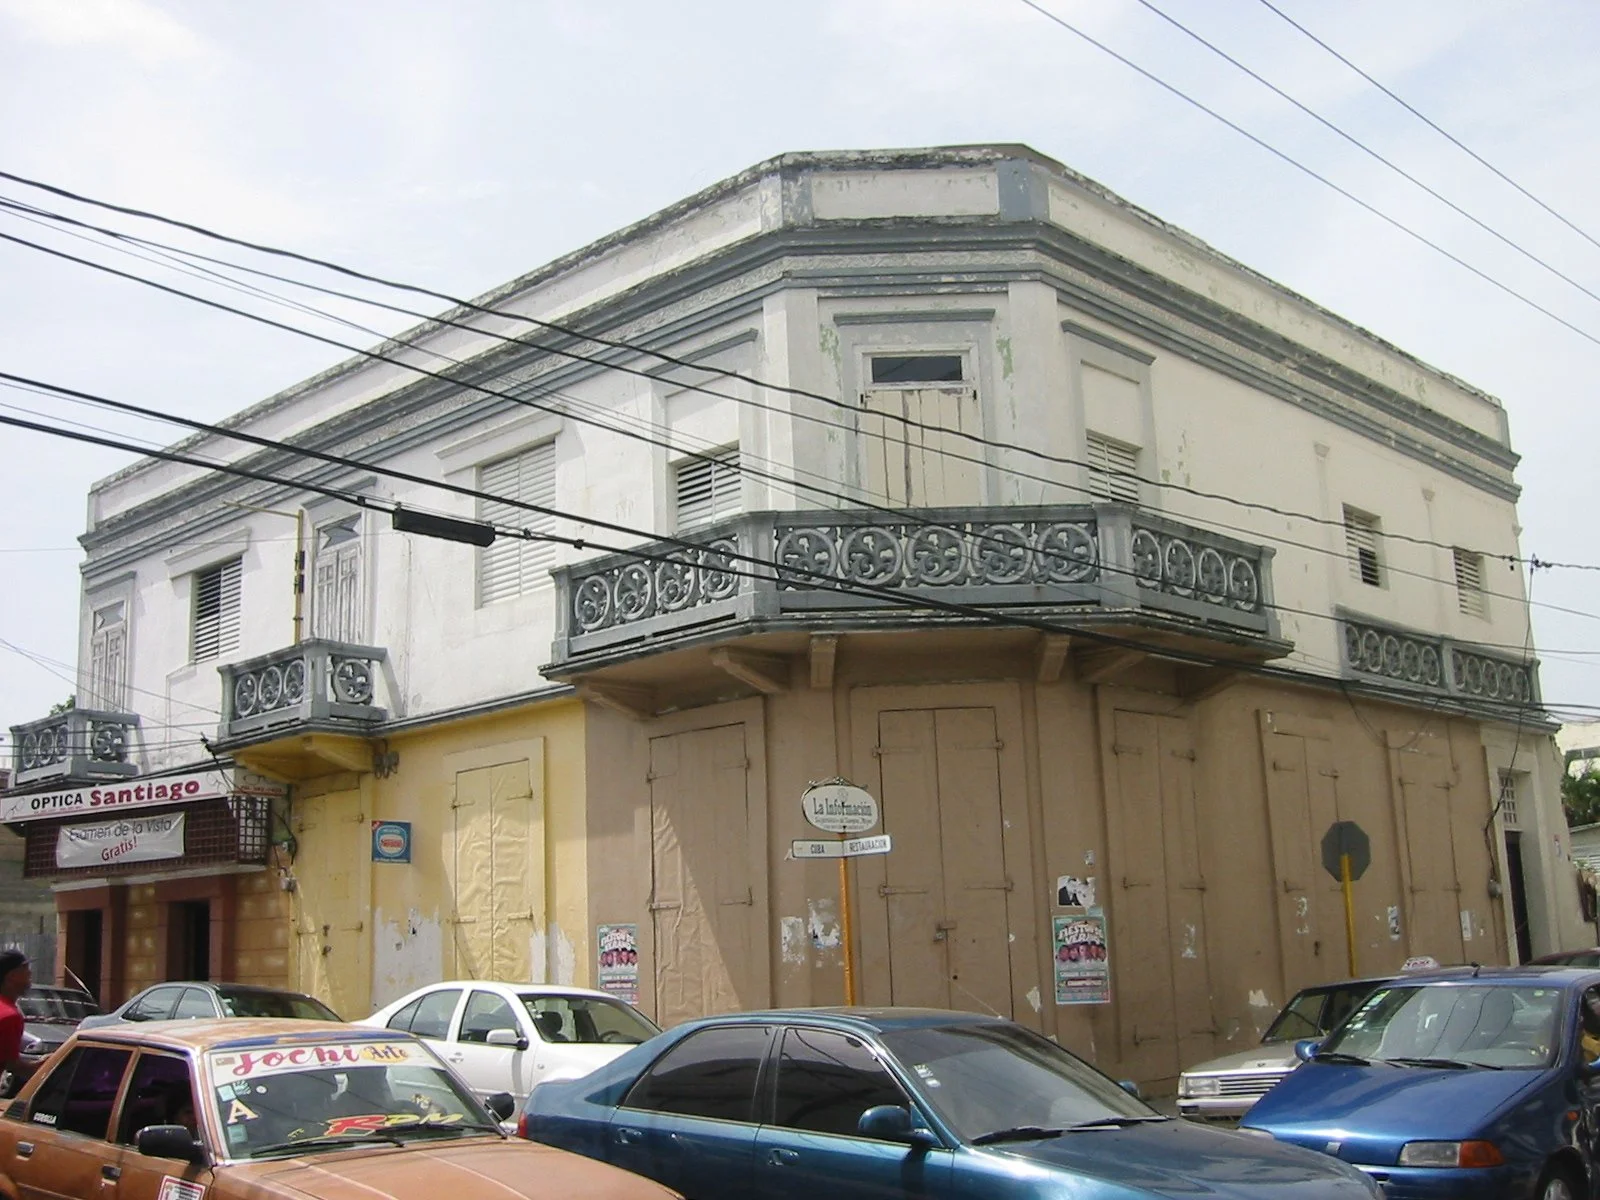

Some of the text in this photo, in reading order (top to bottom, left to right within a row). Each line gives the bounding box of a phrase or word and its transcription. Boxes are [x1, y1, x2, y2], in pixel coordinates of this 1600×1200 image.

[31, 779, 200, 811] OPTICA Santiago
[813, 797, 824, 815] La
[69, 817, 172, 842] Examen de la Vista
[101, 837, 137, 862] Gratis!
[810, 844, 825, 854] CUBA
[232, 1045, 360, 1076] Jochi
[227, 1099, 259, 1125] A
